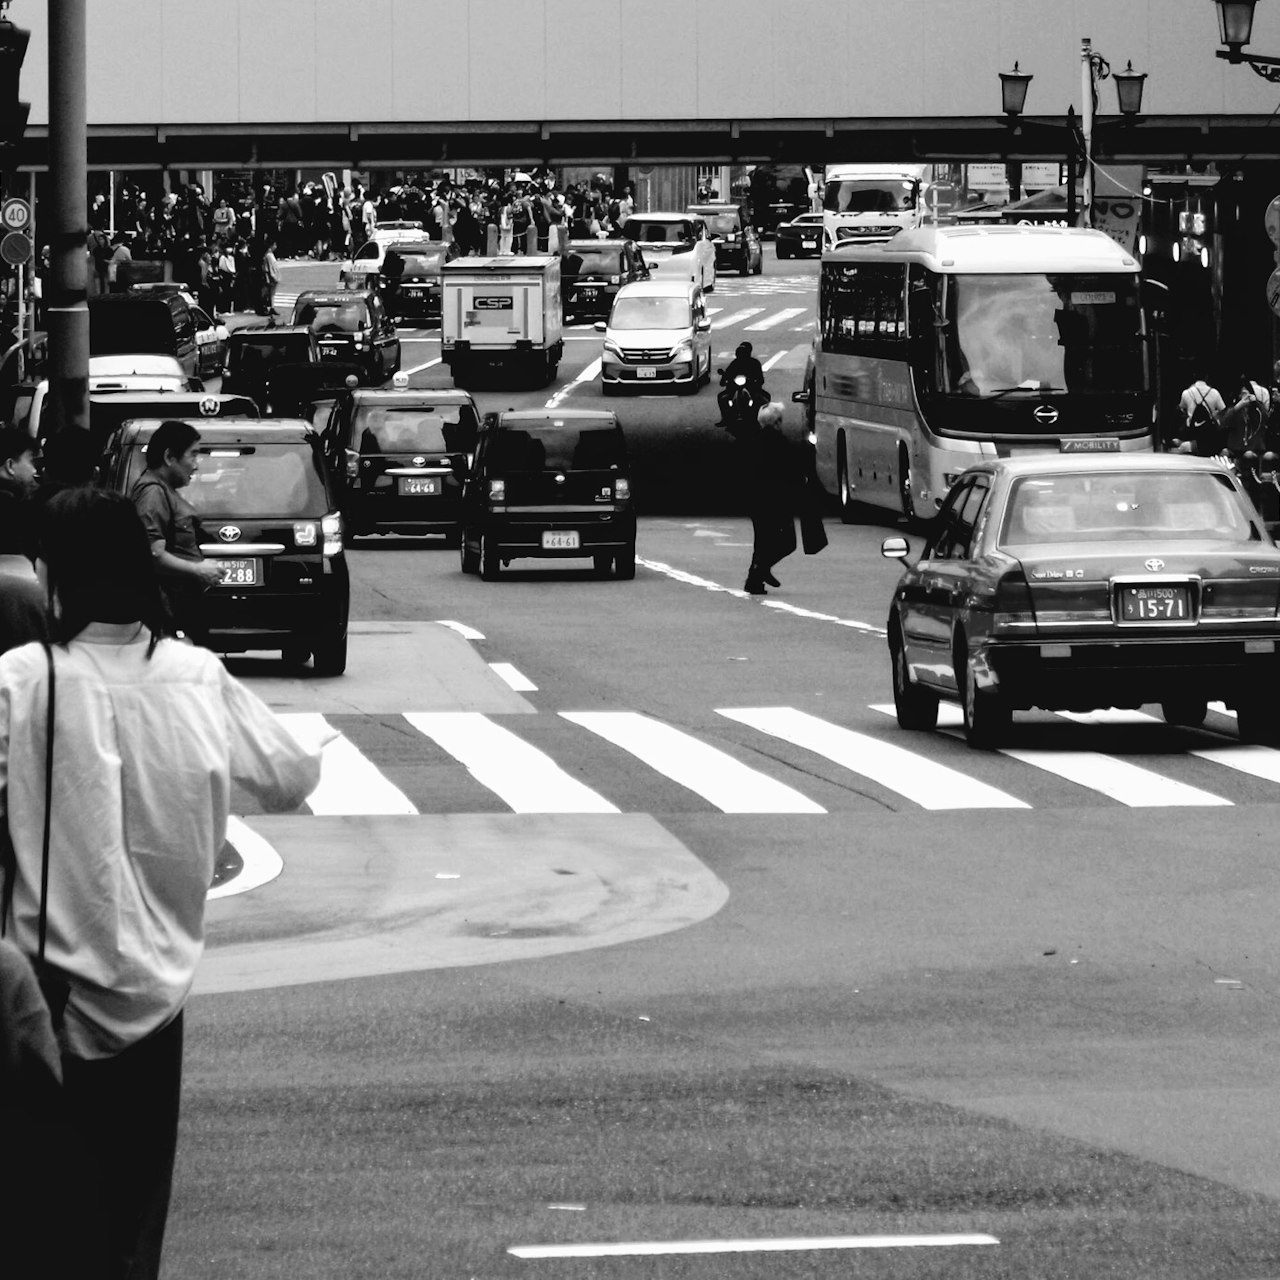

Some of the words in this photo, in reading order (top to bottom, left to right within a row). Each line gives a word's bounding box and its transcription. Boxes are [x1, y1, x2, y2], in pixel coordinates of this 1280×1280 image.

[474, 298, 512, 309] CSP
[1073, 442, 1119, 450] MOBILITY
[551, 537, 576, 547] 64-61
[1139, 599, 1184, 617] 15-71
